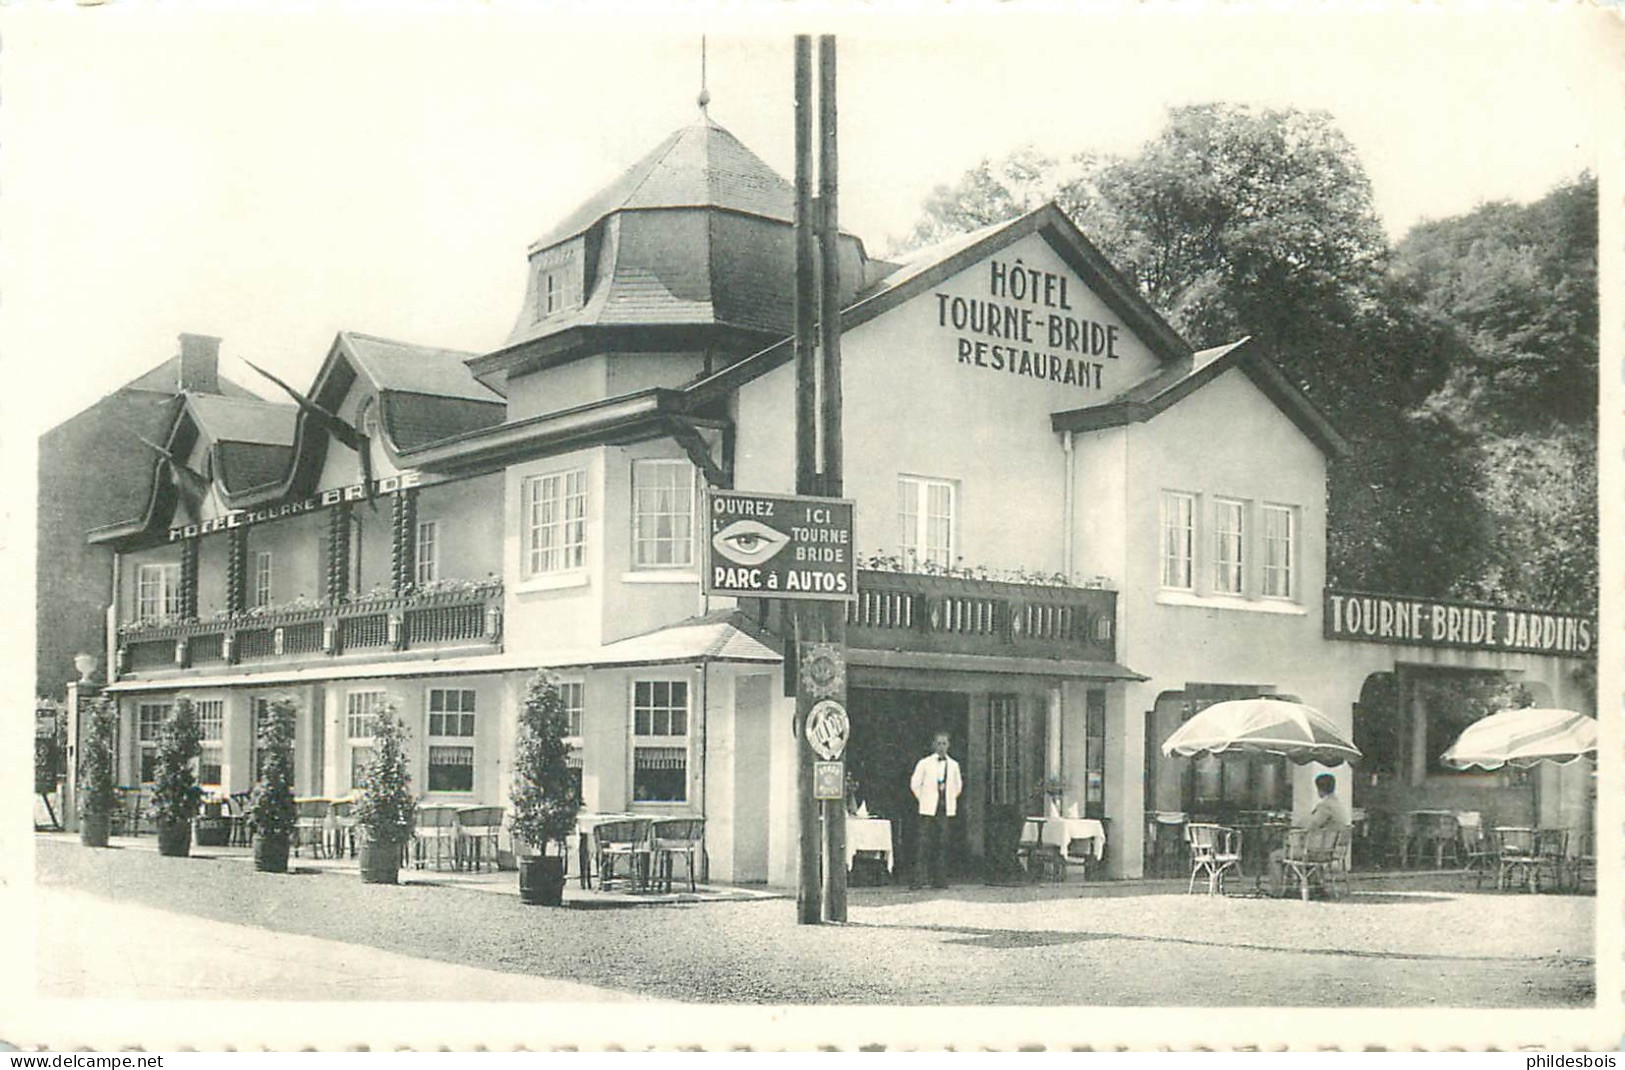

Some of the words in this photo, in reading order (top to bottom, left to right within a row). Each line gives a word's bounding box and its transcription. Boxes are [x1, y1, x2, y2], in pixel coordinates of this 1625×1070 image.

[991, 258, 1072, 310] HÔTEL
[935, 293, 1119, 359] TOURNE-BRIDE
[958, 337, 1104, 390] RESTAURANT
[714, 499, 774, 516] OUVREZ
[806, 508, 831, 523] ICI
[791, 527, 848, 544] TOURNE
[796, 547, 844, 562] BRIDE
[715, 567, 761, 588] PARC
[767, 570, 778, 589] à
[786, 570, 848, 591] AUTOS
[1331, 595, 1498, 646] TOURNE-BRIDE
[1504, 611, 1591, 652] JARDINS
